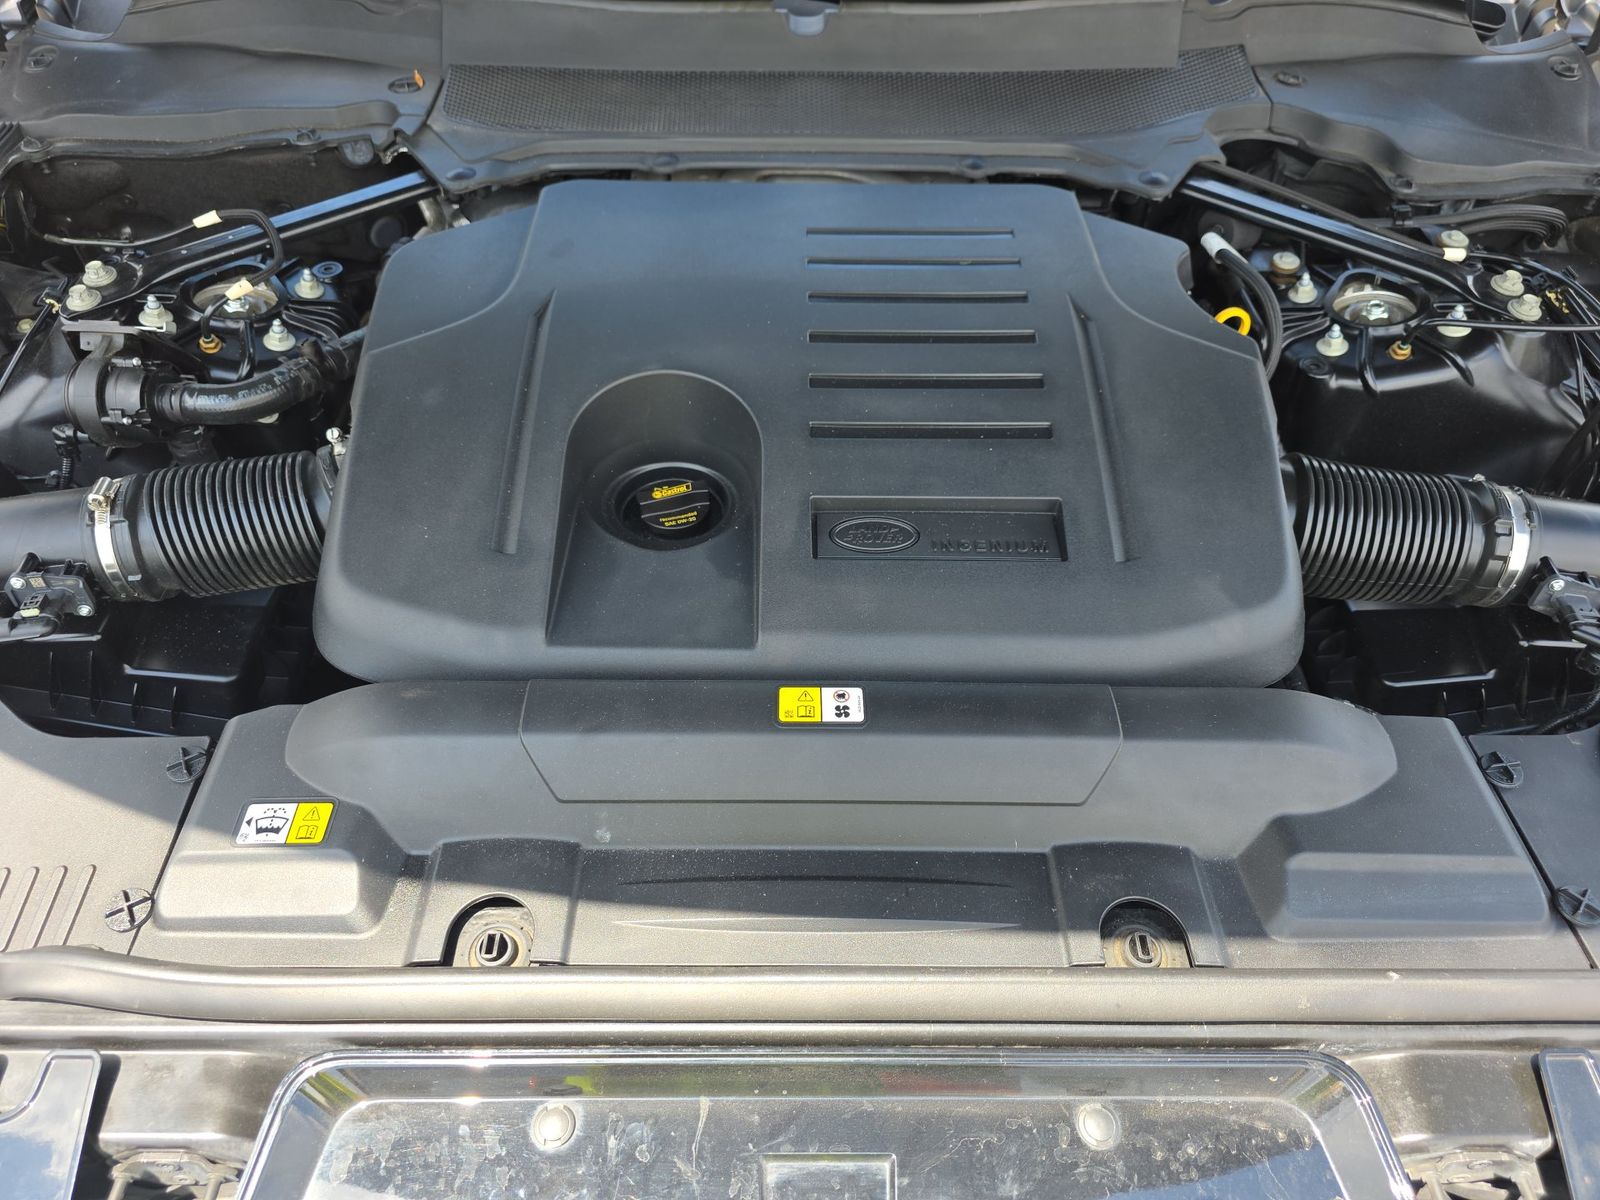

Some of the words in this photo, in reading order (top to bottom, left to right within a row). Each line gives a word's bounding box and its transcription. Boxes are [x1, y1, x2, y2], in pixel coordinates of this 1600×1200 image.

[661, 484, 688, 497] Castrol
[852, 535, 904, 544] ROVER
[930, 538, 1049, 553] INGENIUM
